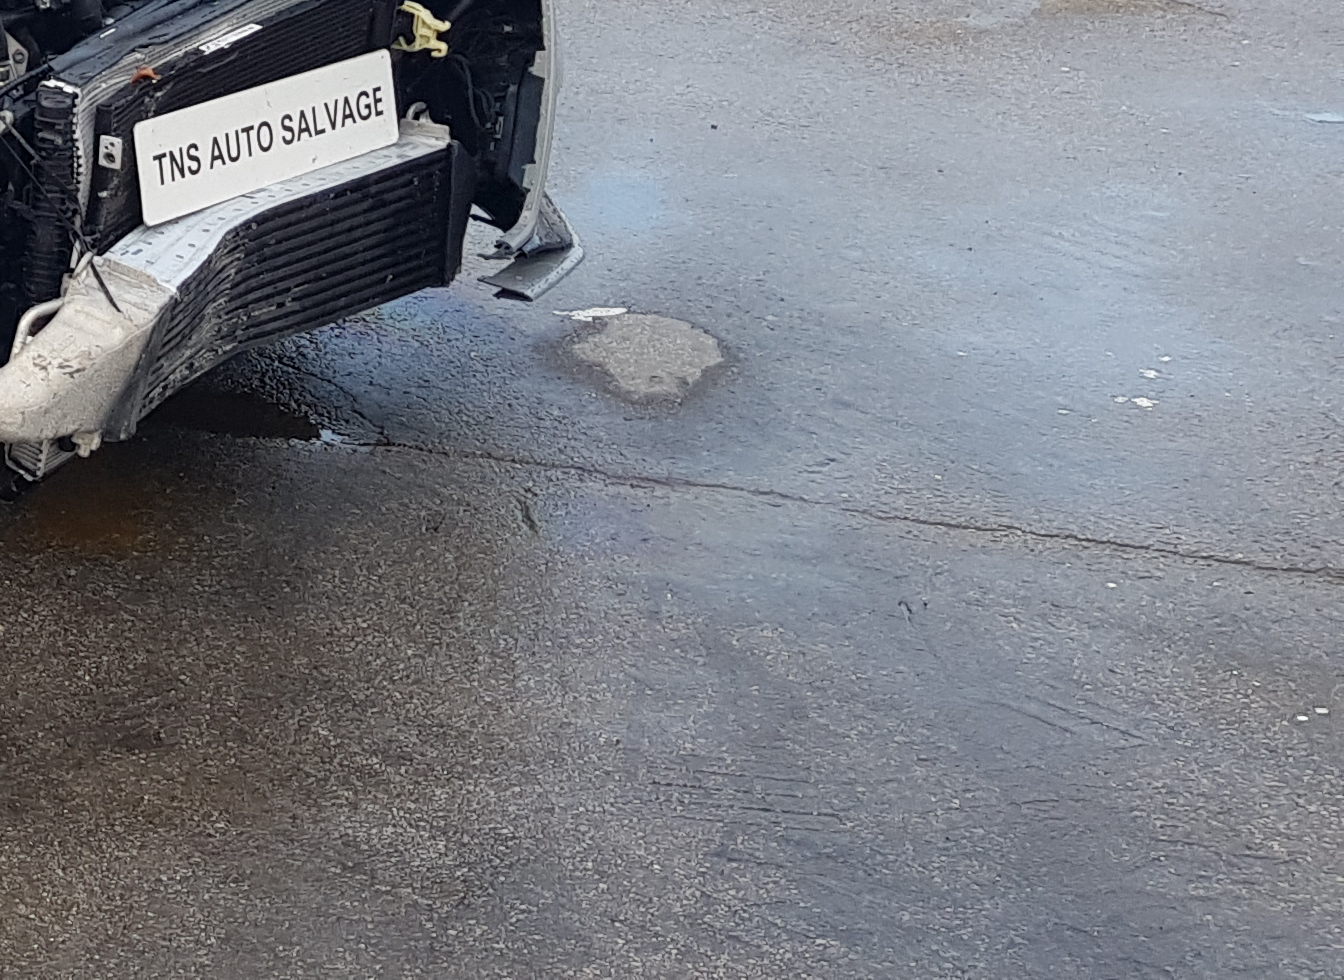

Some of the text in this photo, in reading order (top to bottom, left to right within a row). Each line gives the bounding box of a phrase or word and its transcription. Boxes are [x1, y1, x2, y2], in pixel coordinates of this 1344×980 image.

[152, 86, 384, 186] TNS AUTO SALVAGE
